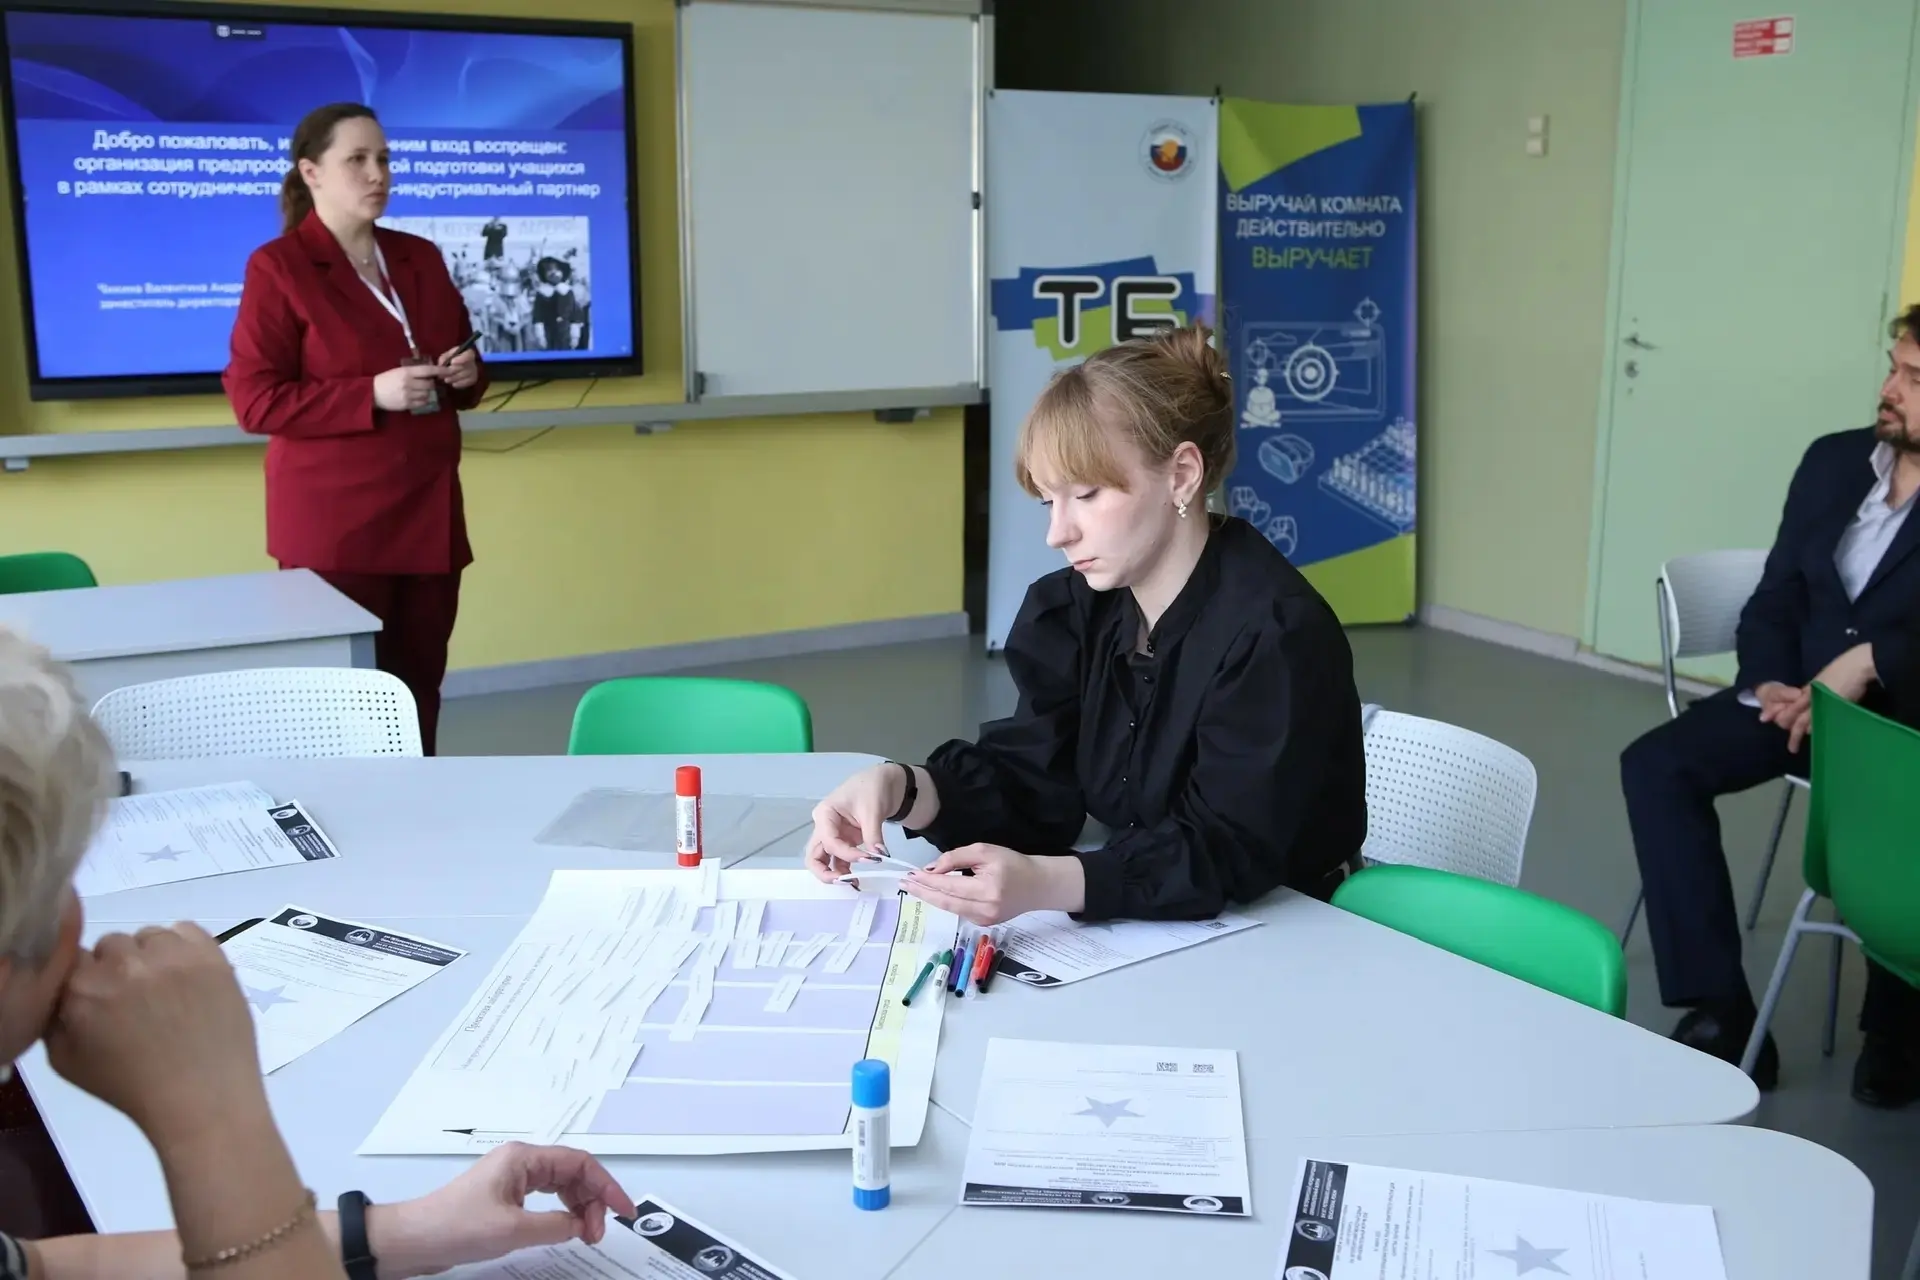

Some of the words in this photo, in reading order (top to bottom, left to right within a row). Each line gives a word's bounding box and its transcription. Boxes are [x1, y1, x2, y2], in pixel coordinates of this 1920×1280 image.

[93, 130, 155, 151] Добро
[159, 134, 274, 151] пожаловать,
[430, 139, 470, 154] вход
[73, 156, 194, 174] организация
[198, 156, 295, 175] предпроф
[413, 161, 505, 177] подготовки
[508, 161, 585, 178] учащихся
[57, 180, 71, 195] в
[74, 180, 143, 197] рамках
[147, 180, 282, 199] сотрудничеств
[536, 182, 601, 199] партнер
[1226, 193, 1318, 213] ВЫРУЧАЙ
[1320, 195, 1403, 214] КОМНАТА
[1235, 216, 1386, 239] ДЕЙСТВИТЕЛЬНО
[1251, 246, 1374, 269] ВЫРУЧАЕТ
